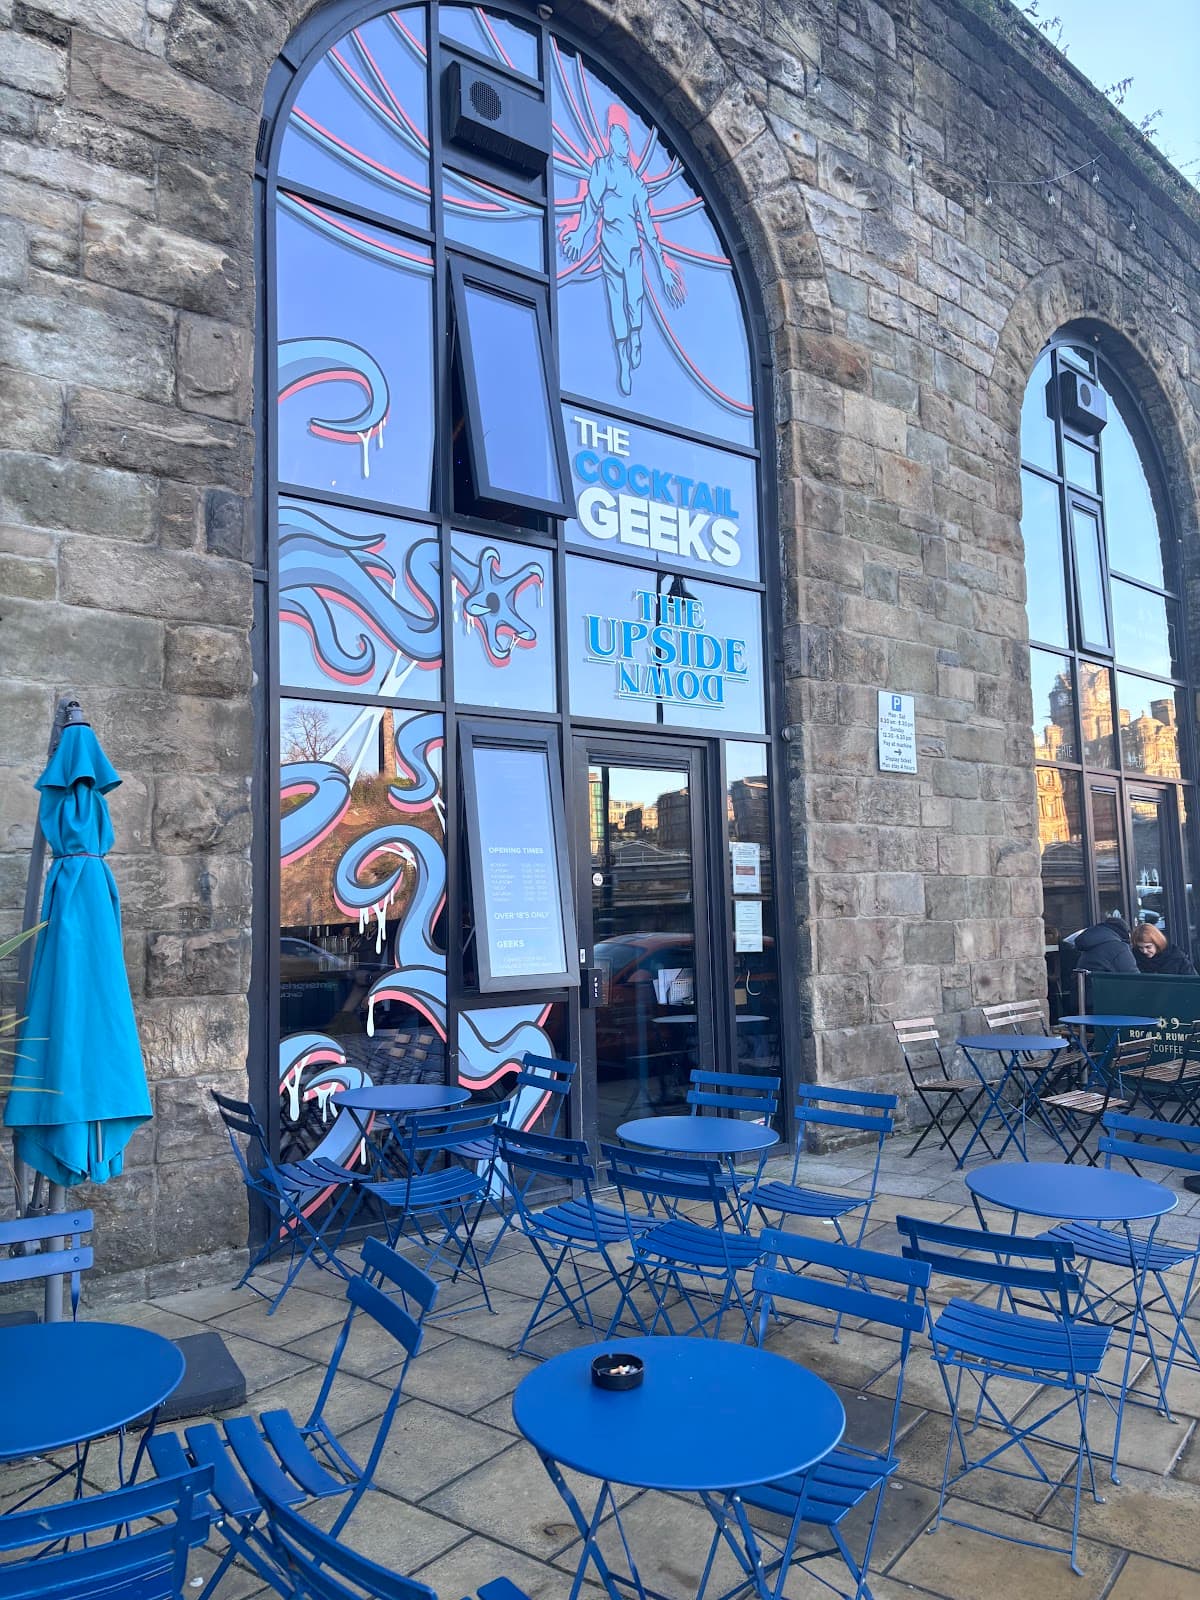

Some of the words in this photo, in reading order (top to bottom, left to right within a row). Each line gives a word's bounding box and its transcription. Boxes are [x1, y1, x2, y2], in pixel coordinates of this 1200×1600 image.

[574, 415, 630, 457] THE
[575, 450, 739, 519] COCKTAIL
[578, 486, 742, 568] GEEKS
[635, 588, 706, 631] THE
[586, 613, 748, 676] UPSIDE
[618, 662, 725, 703] DOWN
[497, 939, 525, 949] GEEKS
[1154, 1044, 1184, 1054] COFFEE
